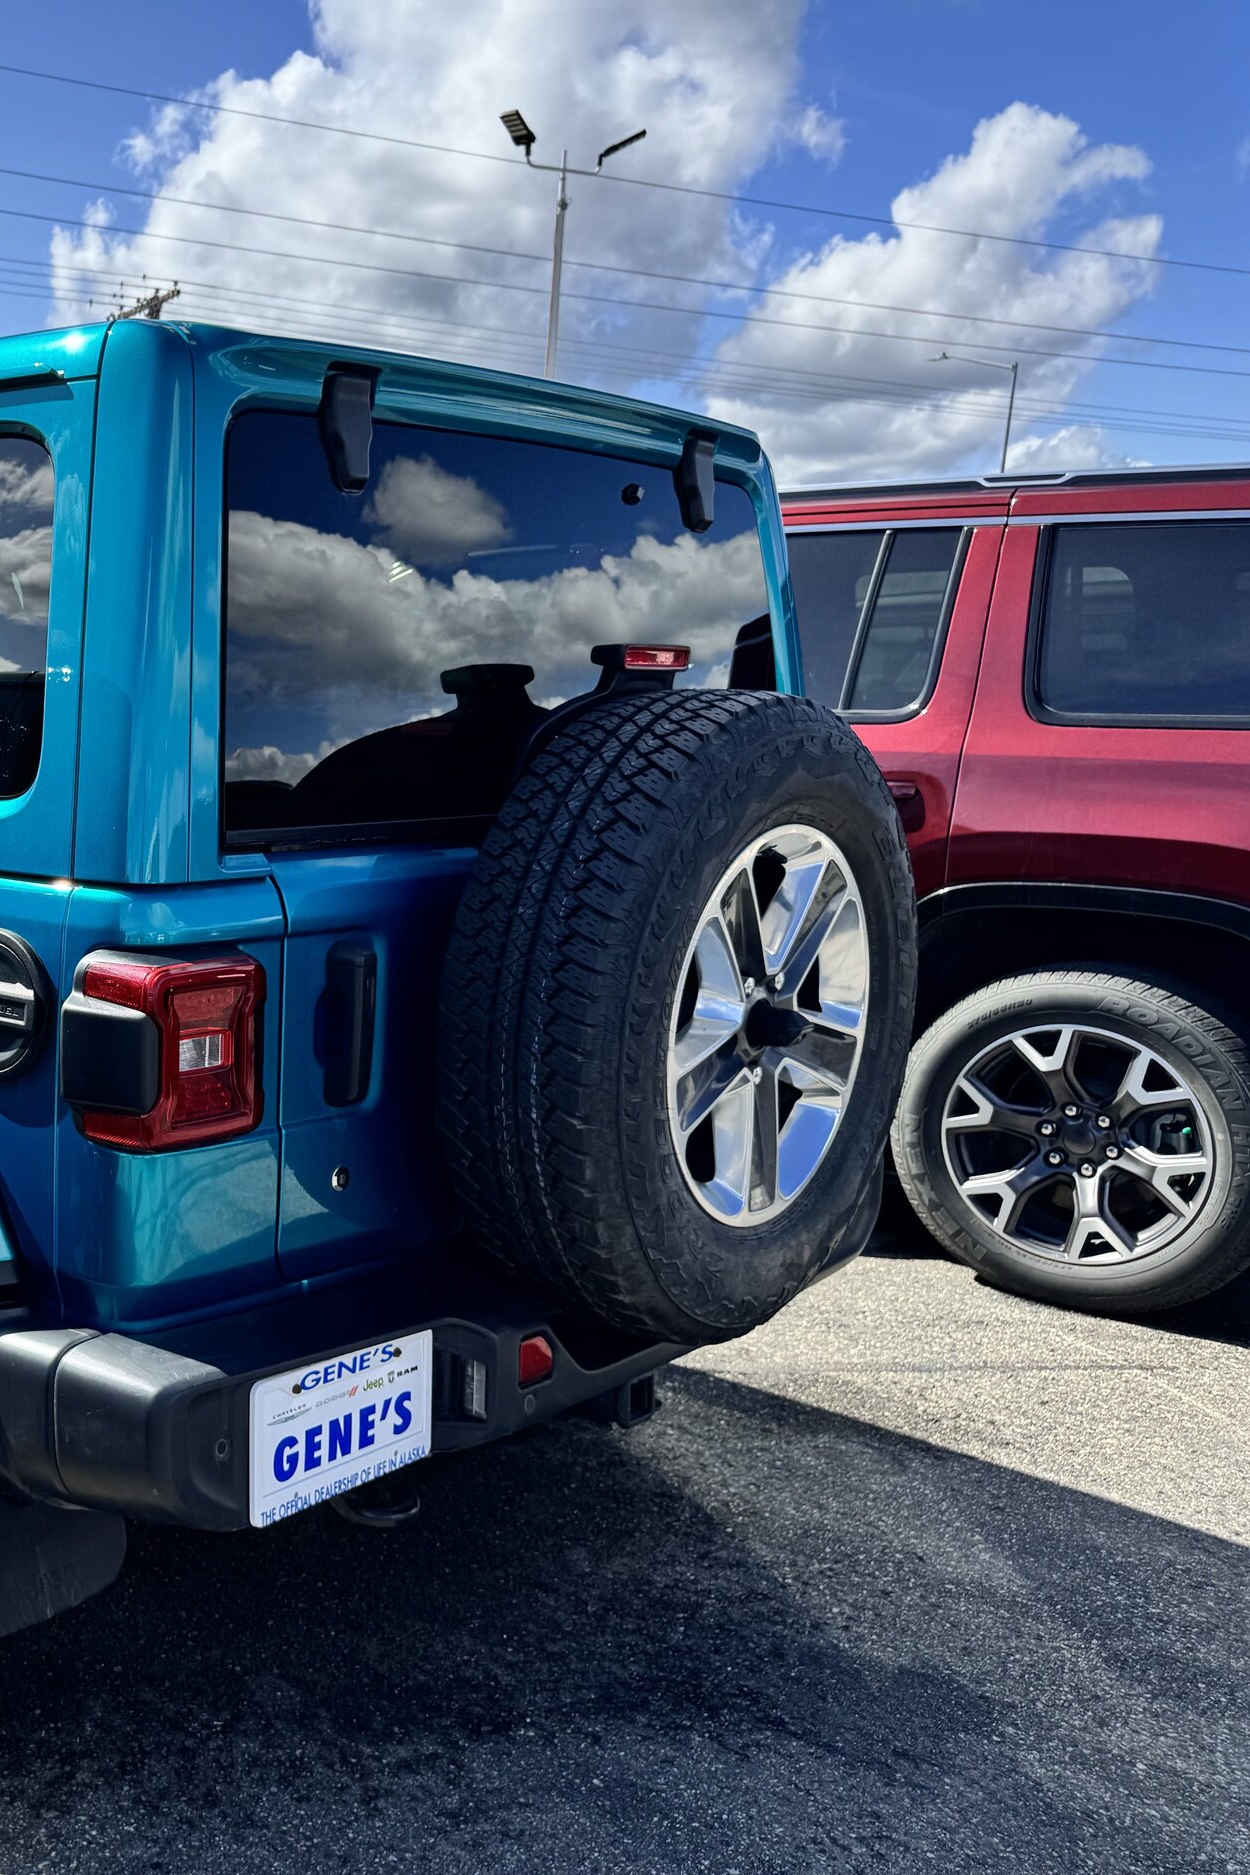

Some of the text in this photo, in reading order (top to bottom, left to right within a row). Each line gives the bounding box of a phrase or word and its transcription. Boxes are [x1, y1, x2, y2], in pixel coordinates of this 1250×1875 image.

[1097, 996, 1245, 1112] ROADIAN
[903, 1111, 989, 1263] NEXEN
[272, 1403, 307, 1420] CHRYSLER
[362, 1376, 384, 1392] Jeep
[396, 1365, 419, 1378] RAM
[300, 1343, 395, 1391] GENE'S
[273, 1391, 412, 1483] GENE'S
[260, 1445, 426, 1527] THE OFFICIAL DEALERSHIP OF LIFE IN ALASKA
